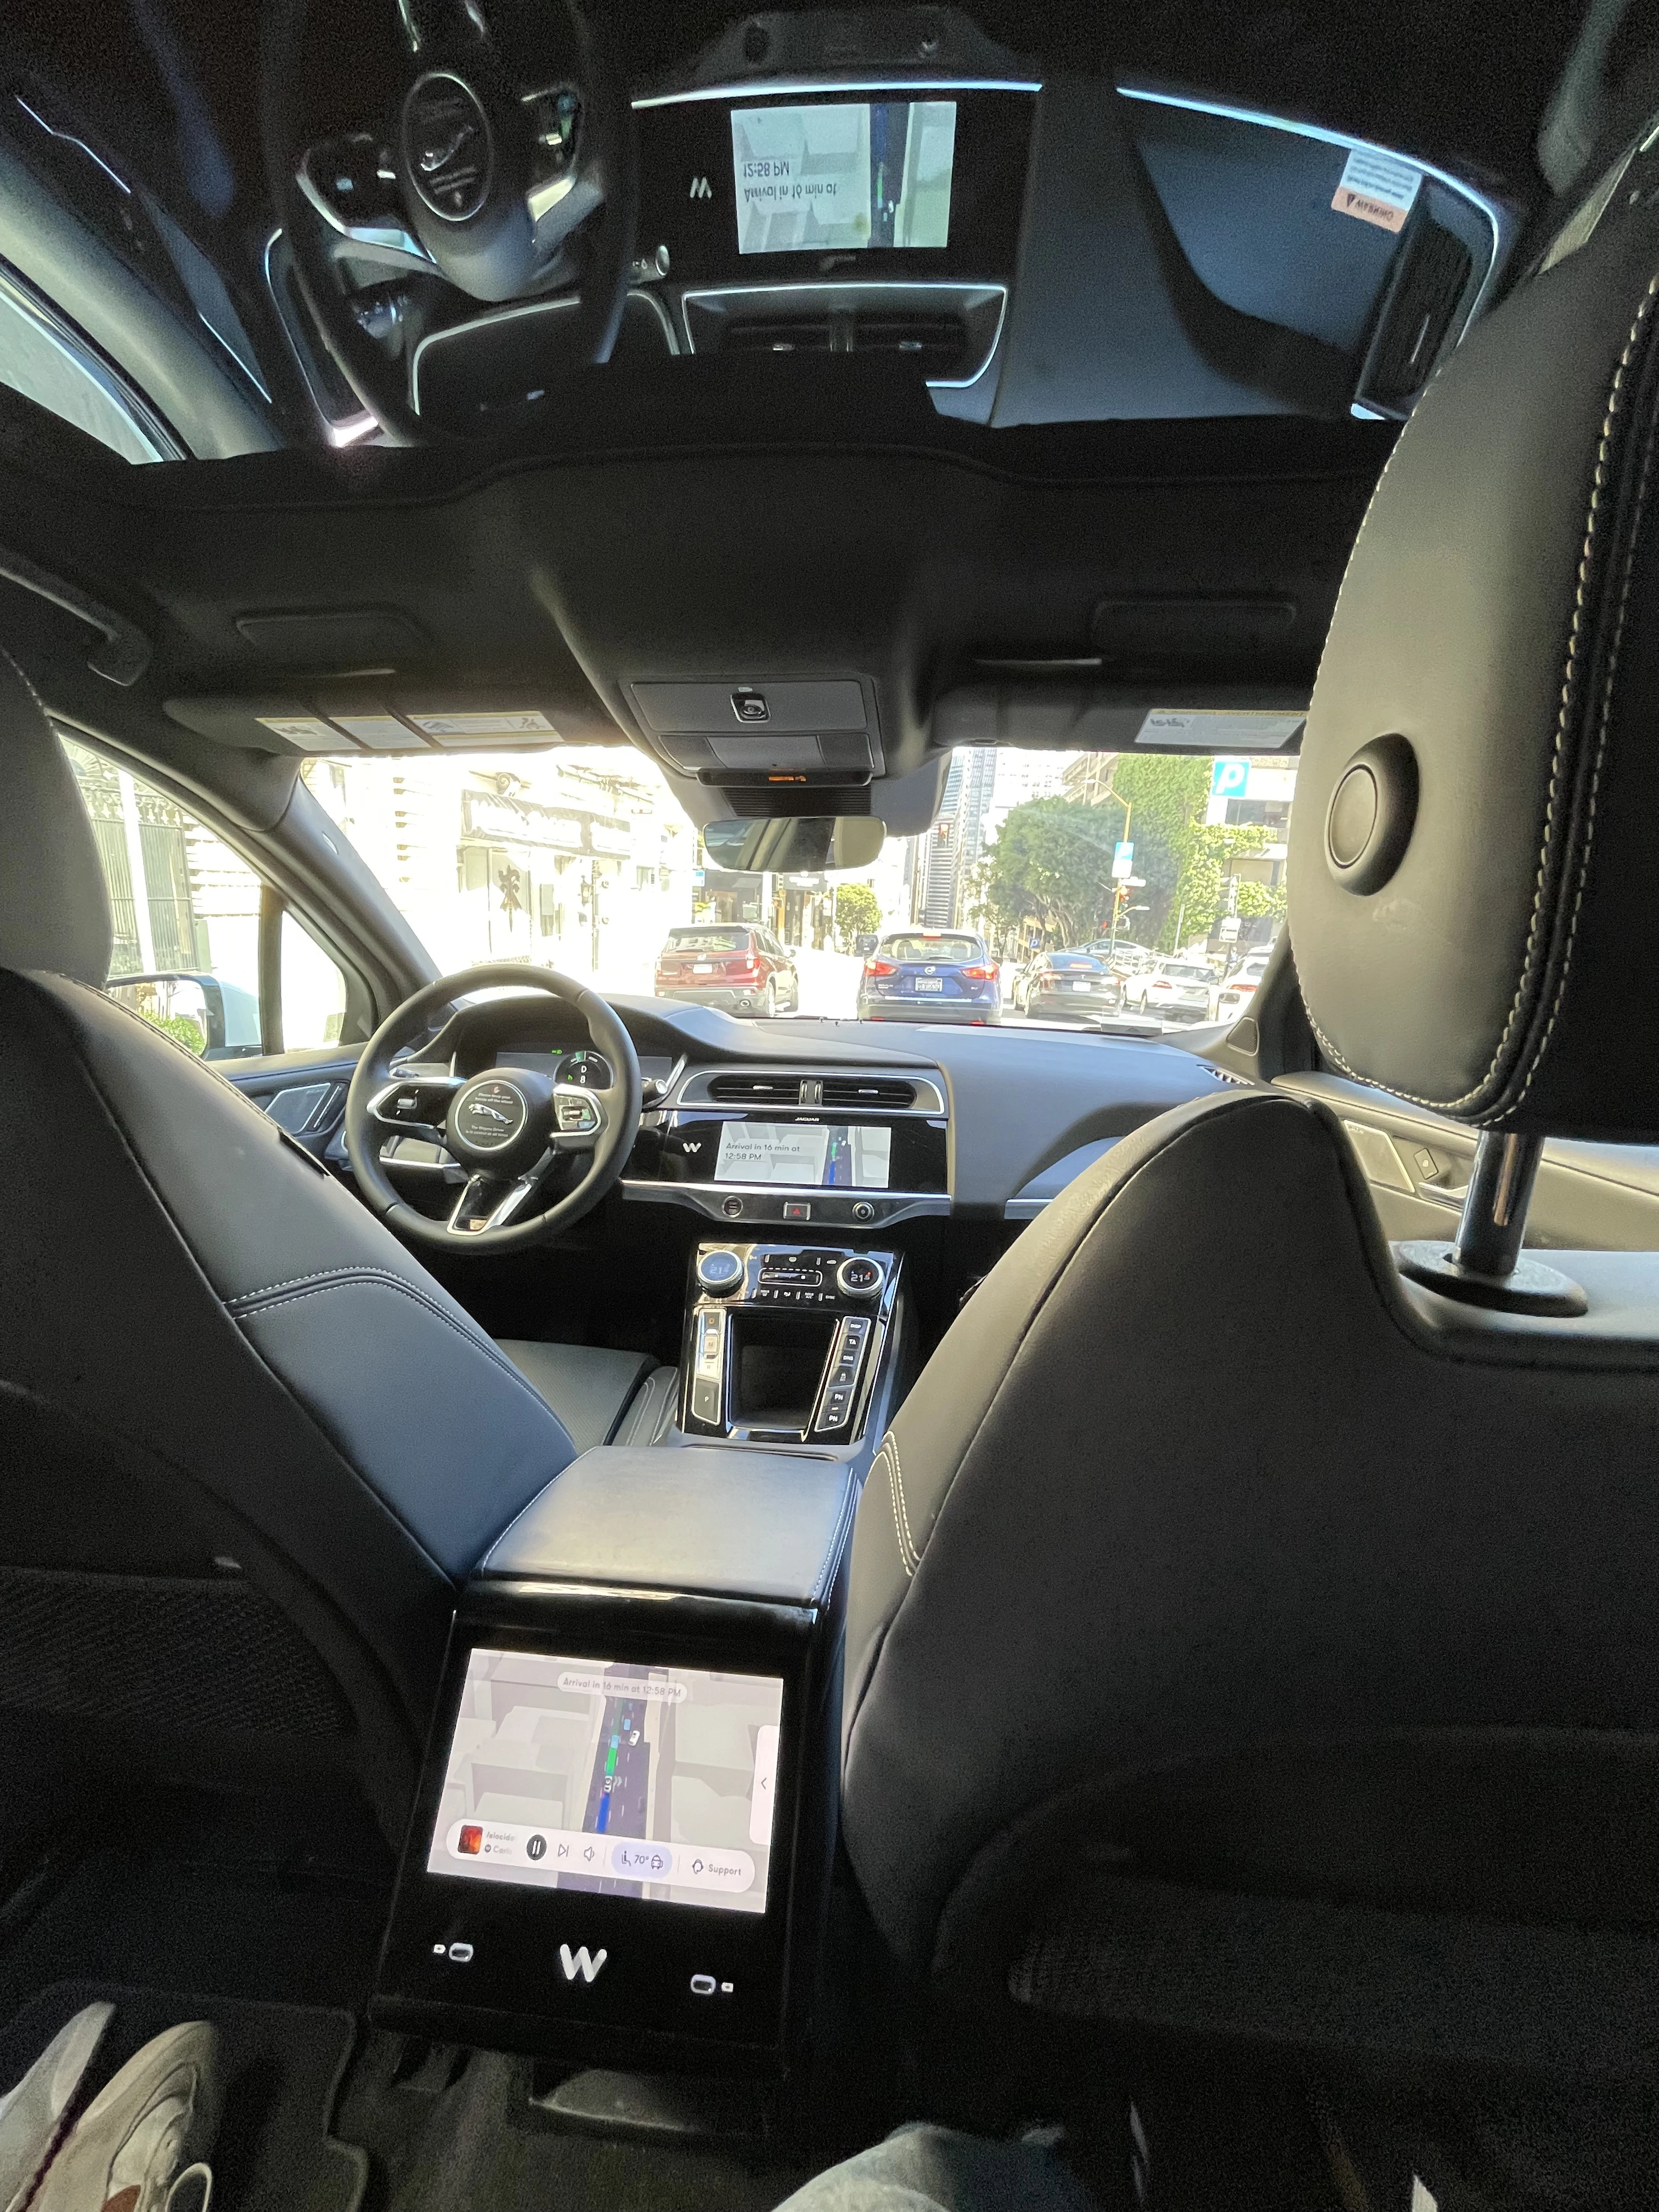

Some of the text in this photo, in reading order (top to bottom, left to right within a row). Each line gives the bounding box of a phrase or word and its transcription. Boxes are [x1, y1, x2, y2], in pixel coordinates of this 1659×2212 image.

[1215, 763, 1245, 794] P
[563, 1677, 590, 1688] Arrival
[603, 1681, 611, 1690] 16
[614, 1683, 629, 1691] min
[643, 1686, 665, 1695] 12:58
[668, 1688, 681, 1697] PM
[634, 1854, 650, 1864] 70°
[708, 1864, 742, 1877] Support
